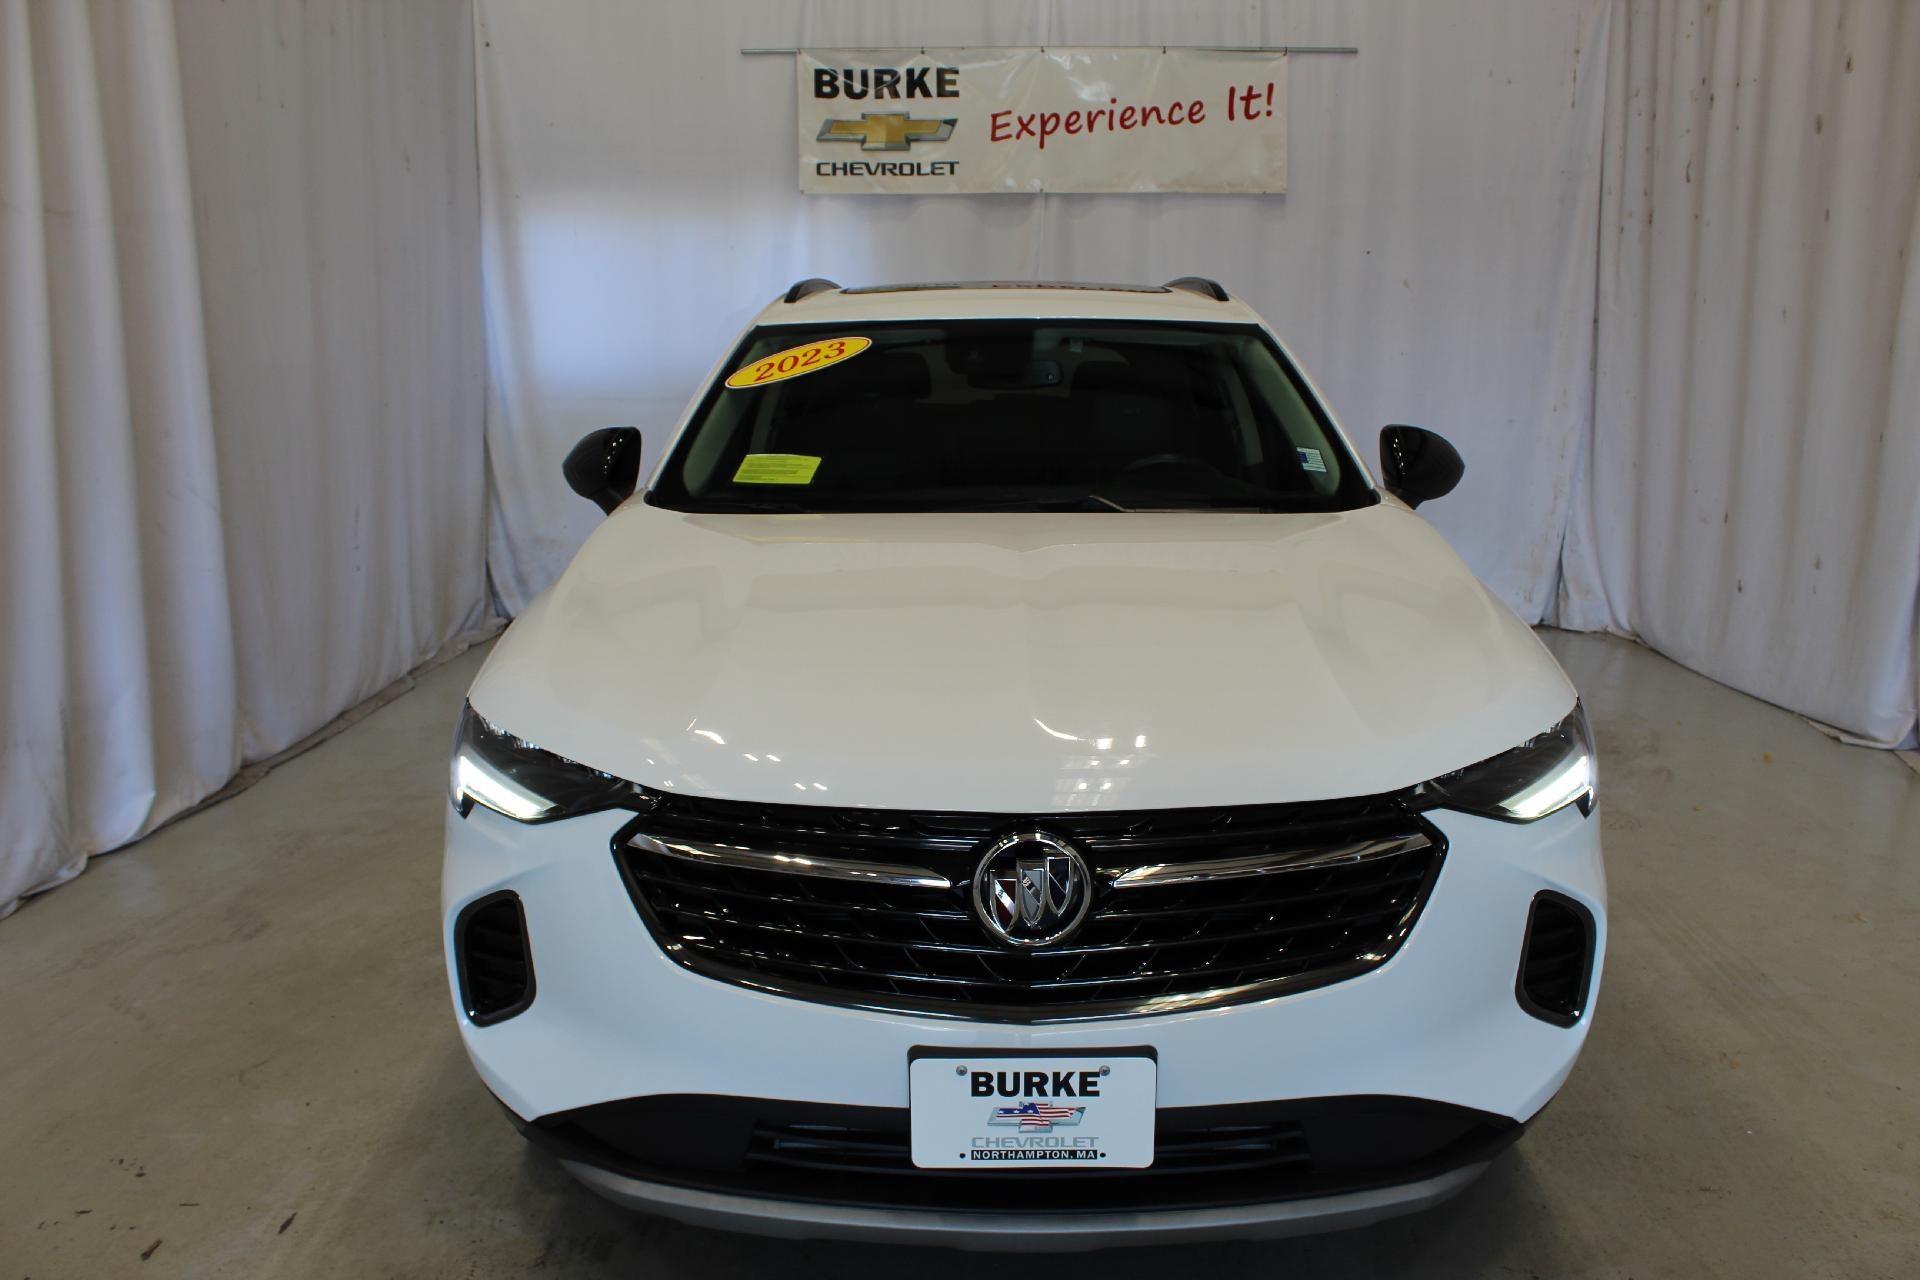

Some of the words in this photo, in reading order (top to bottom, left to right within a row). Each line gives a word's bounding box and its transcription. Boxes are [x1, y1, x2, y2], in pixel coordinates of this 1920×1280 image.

[813, 67, 960, 100] BURKE
[990, 99, 1205, 149] Experience
[1227, 83, 1275, 122] It!
[815, 161, 960, 176] CHEVROLET
[754, 341, 846, 382] 2023
[971, 1071, 1100, 1098] BURKE
[971, 1137, 1099, 1148] CHEVROLET
[1076, 1151, 1095, 1159] MA
